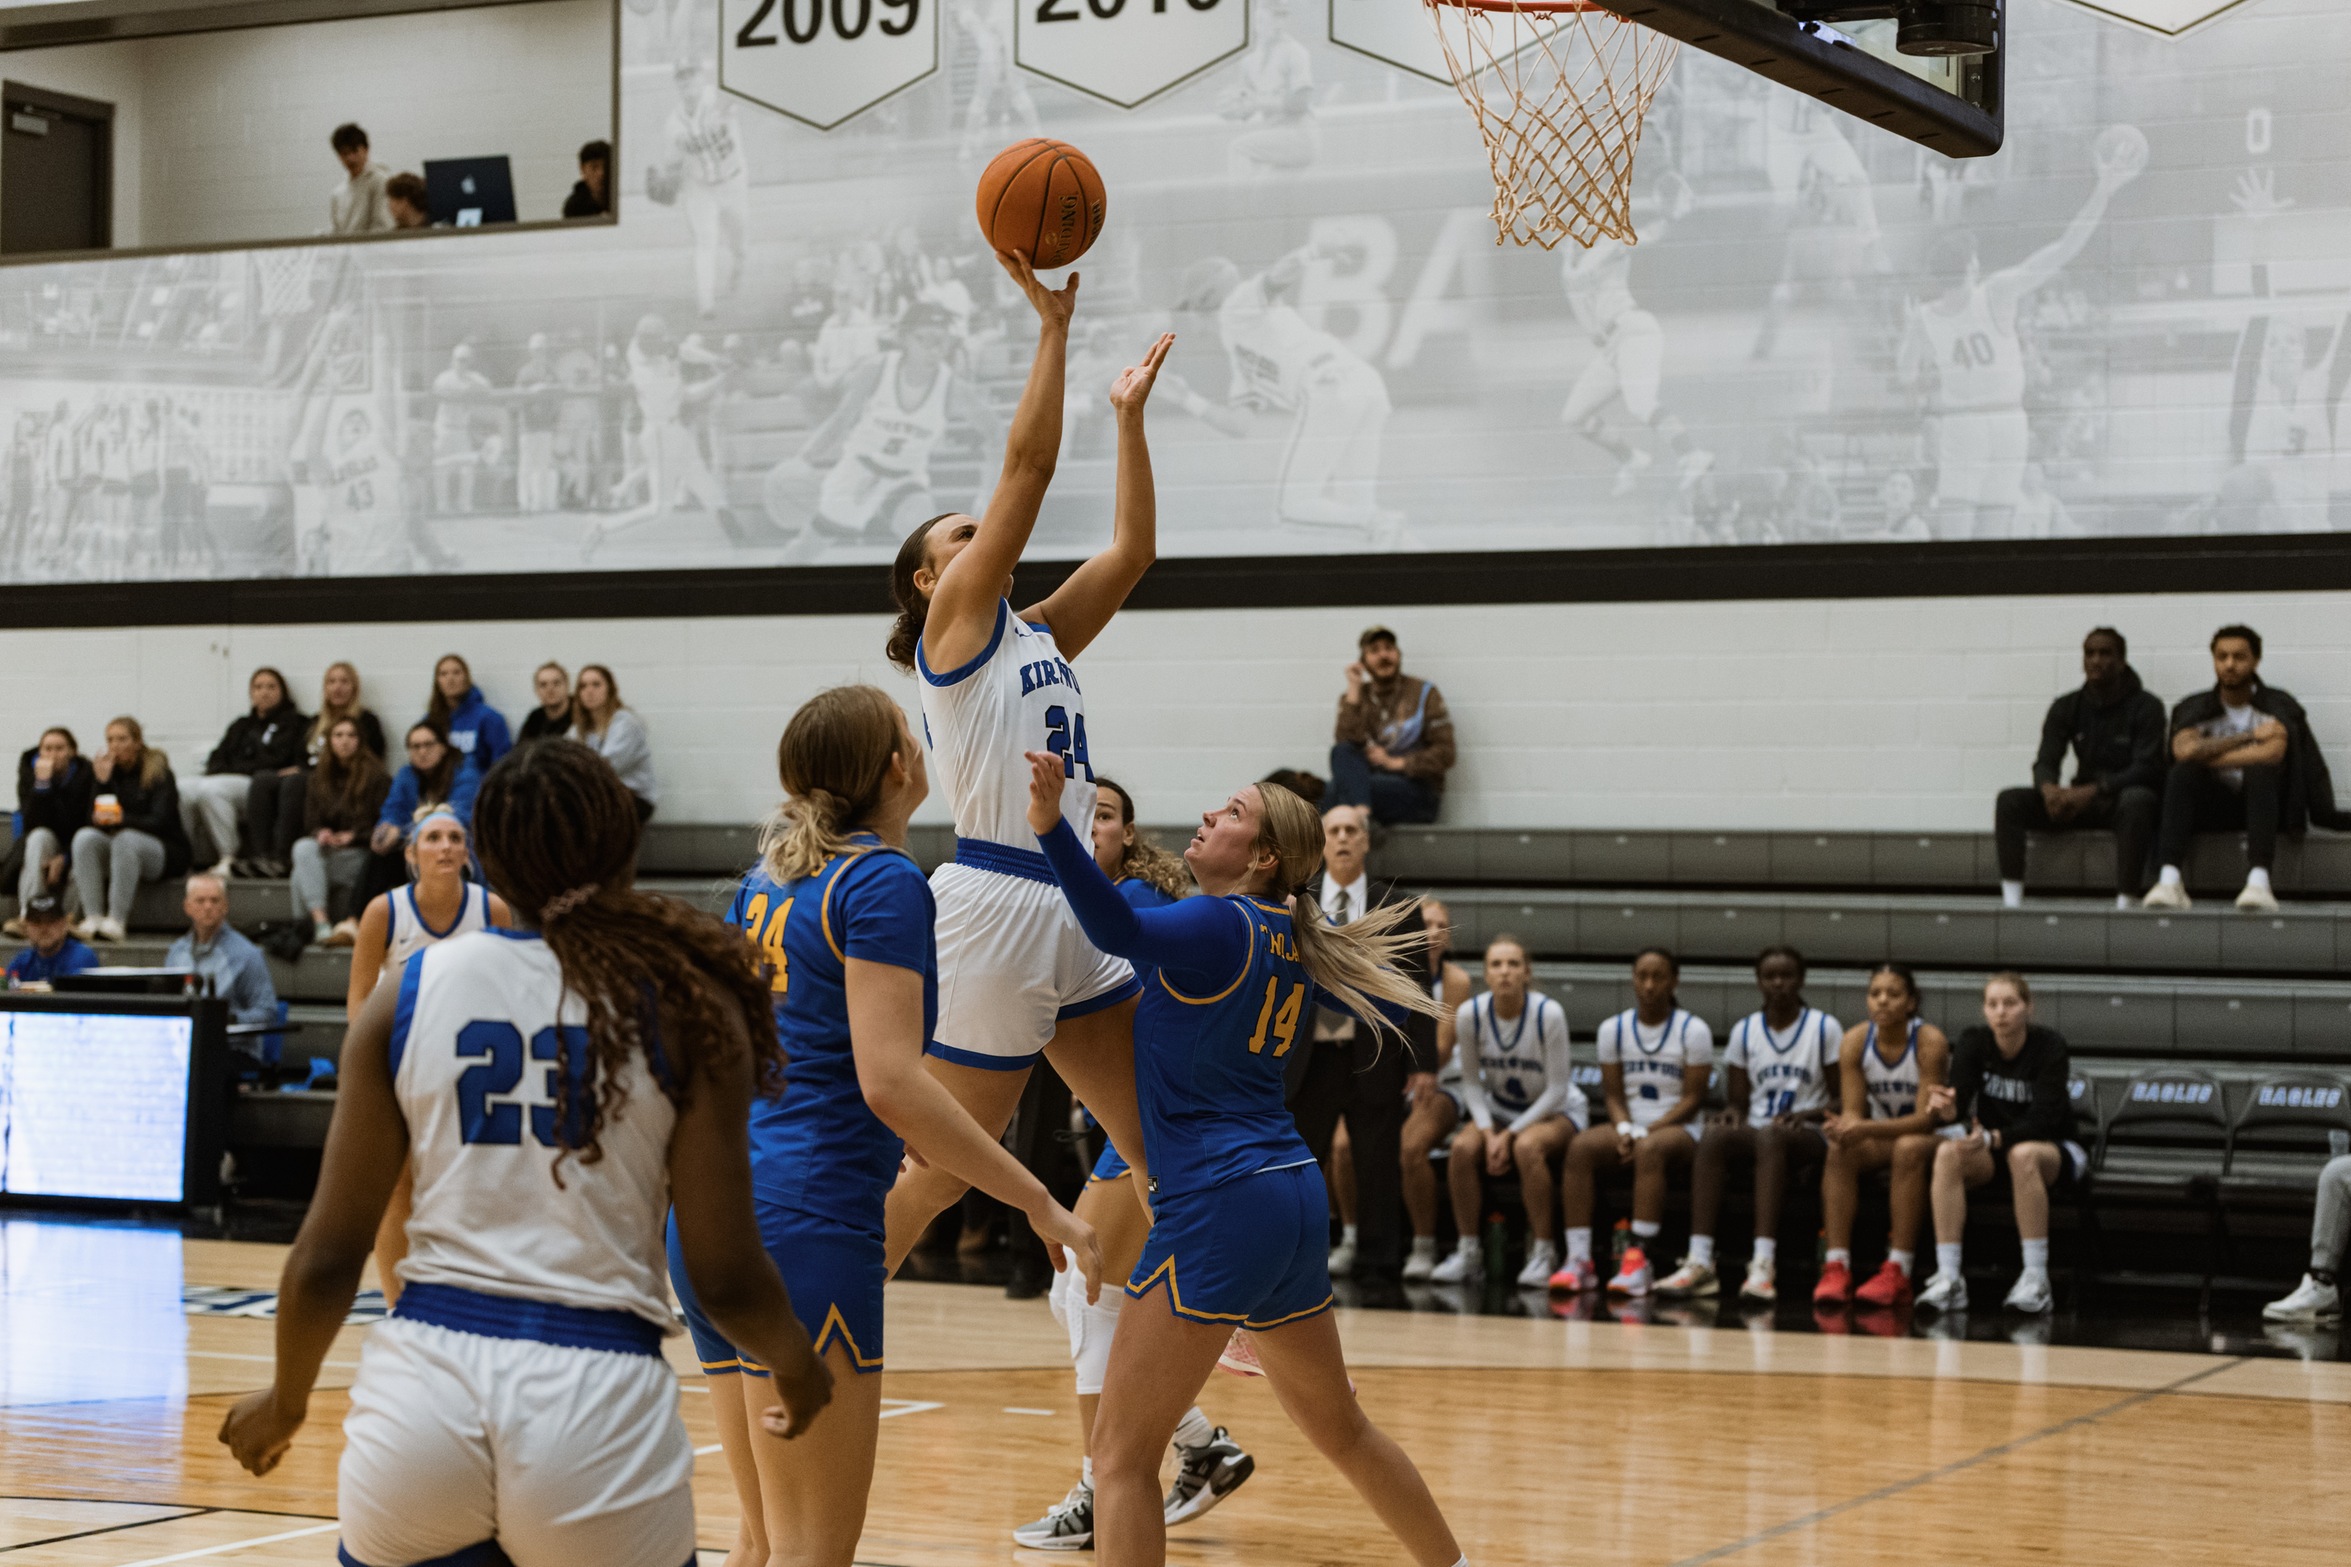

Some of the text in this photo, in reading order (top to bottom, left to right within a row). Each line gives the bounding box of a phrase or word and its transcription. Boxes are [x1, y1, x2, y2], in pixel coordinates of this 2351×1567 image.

[1045, 704, 1097, 784] 24
[1248, 975, 1305, 1057] 14
[455, 1018, 598, 1149] 23
